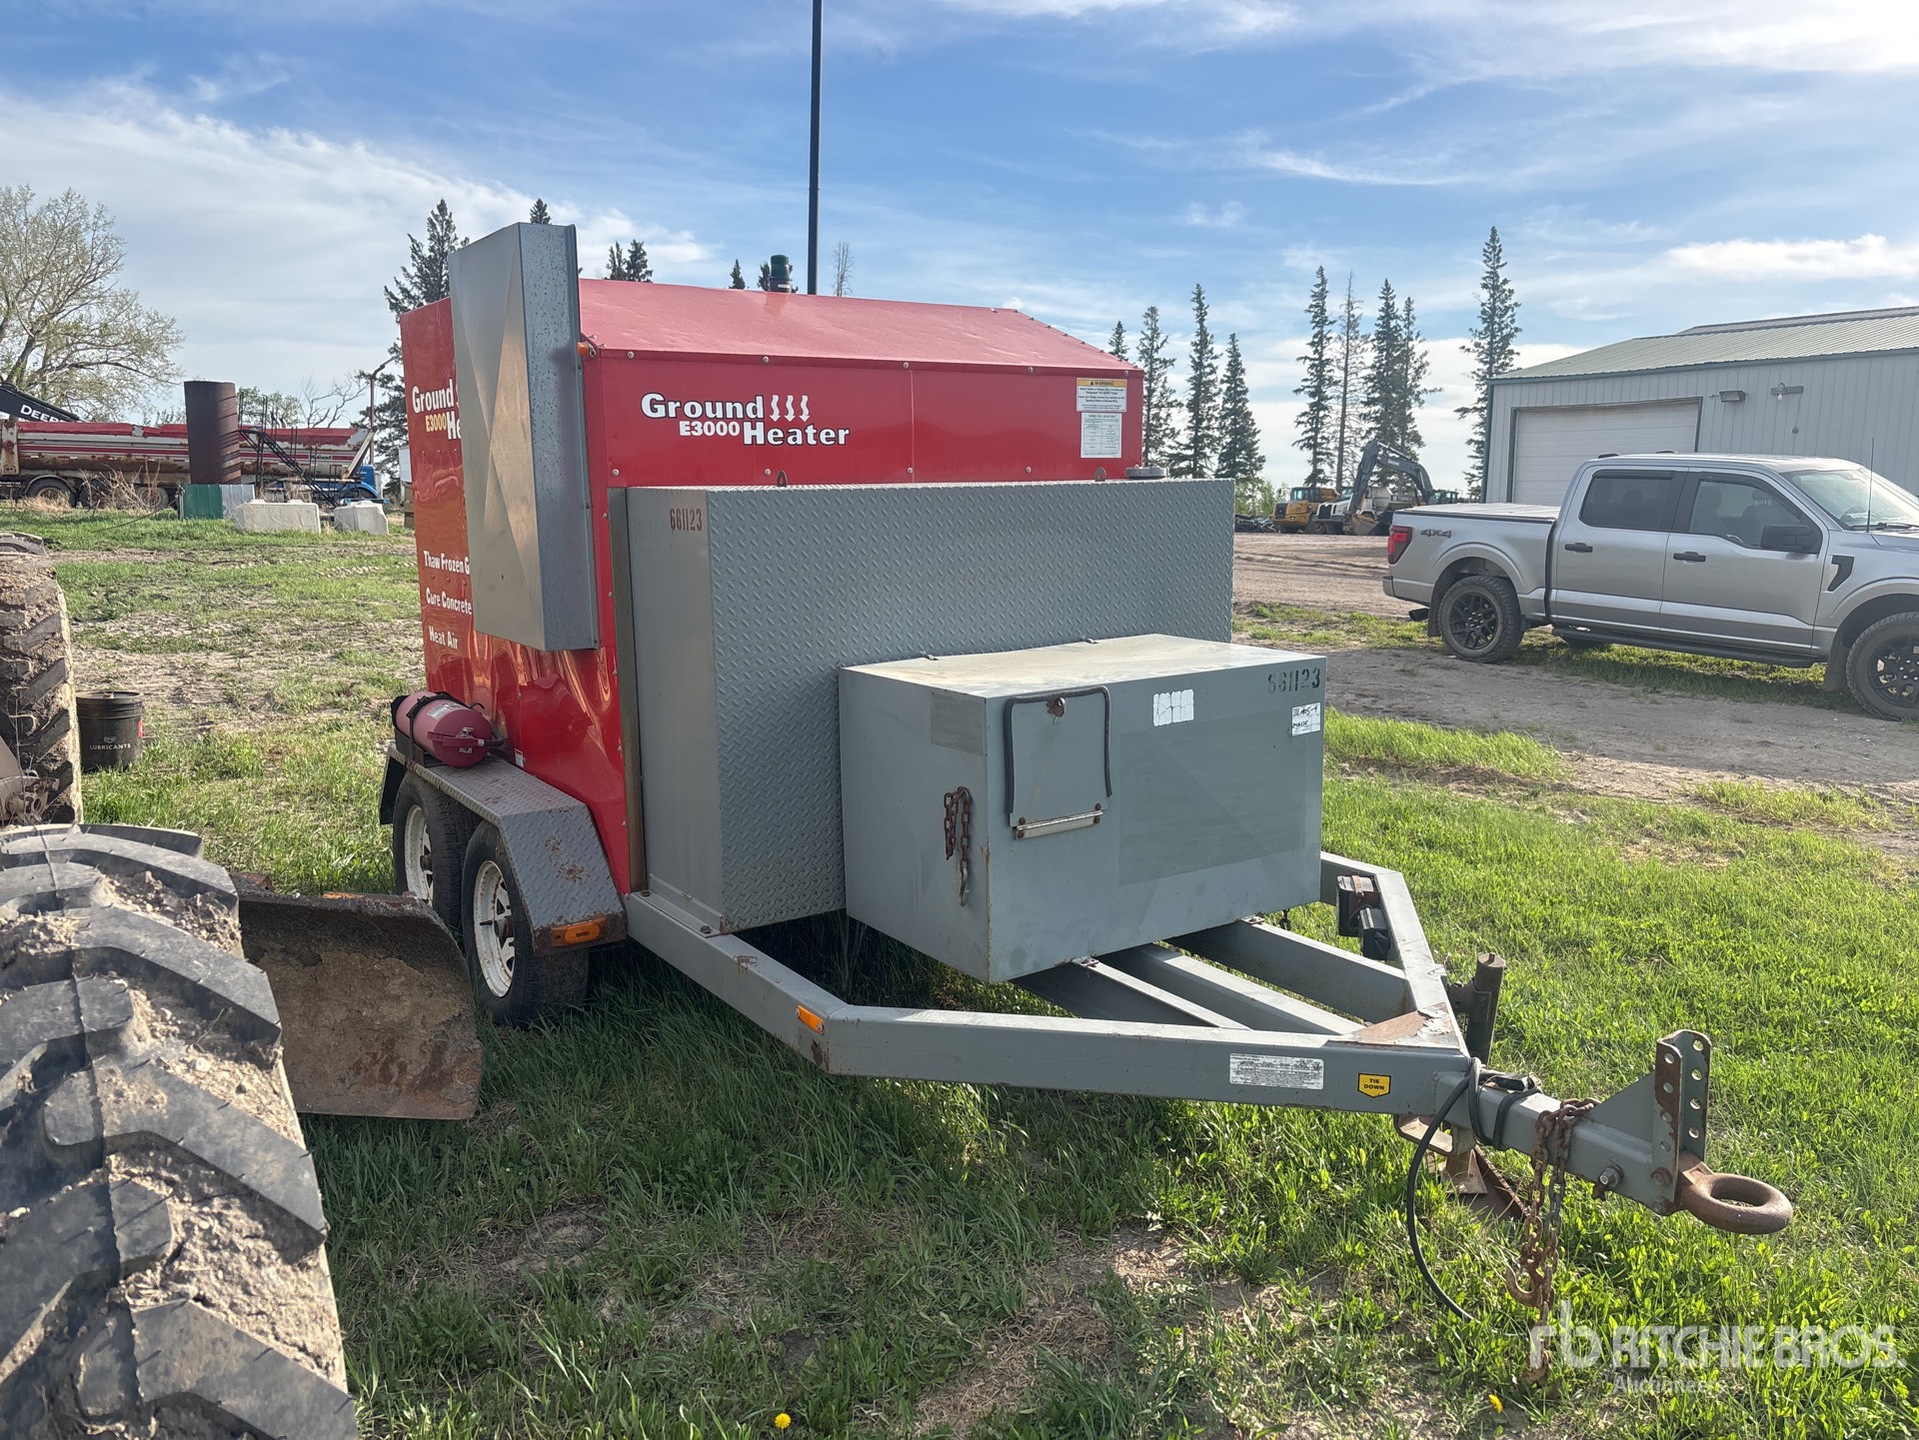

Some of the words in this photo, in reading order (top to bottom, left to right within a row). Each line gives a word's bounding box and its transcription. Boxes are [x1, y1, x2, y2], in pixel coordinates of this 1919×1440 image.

[412, 379, 454, 415] Ground
[641, 393, 765, 419] Ground
[425, 412, 447, 432] E3000
[679, 421, 740, 436] E3000
[743, 421, 850, 445] Heater
[669, 508, 703, 532] 661123
[423, 550, 441, 571] Thaw
[441, 553, 464, 574] Frozen
[426, 587, 441, 608] Cure
[441, 590, 472, 615] Concrete
[429, 625, 446, 646] Heat
[446, 630, 459, 650] Air
